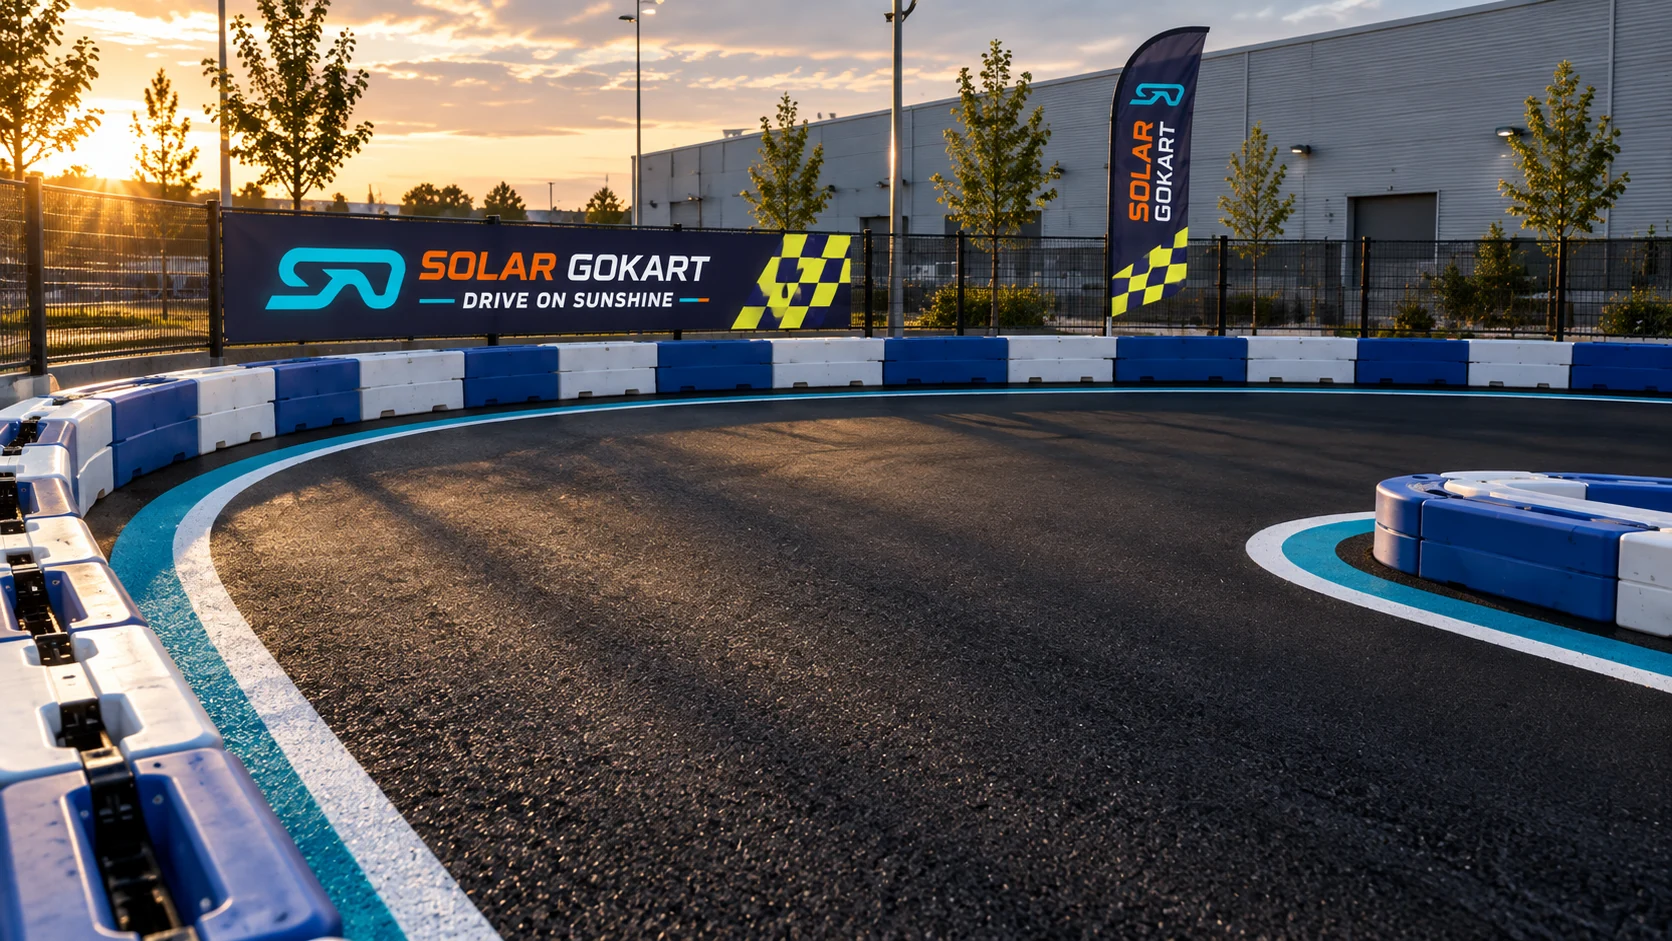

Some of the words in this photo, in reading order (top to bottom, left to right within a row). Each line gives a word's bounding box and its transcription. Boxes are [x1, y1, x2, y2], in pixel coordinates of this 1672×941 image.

[1128, 120, 1154, 222] SOLAR
[1154, 120, 1176, 222] GOKART
[419, 250, 557, 281] SOLAR
[567, 253, 711, 282] GOKART
[462, 292, 529, 309] DRIVE
[536, 291, 567, 309] ON
[572, 291, 673, 308] SUNSHINE
